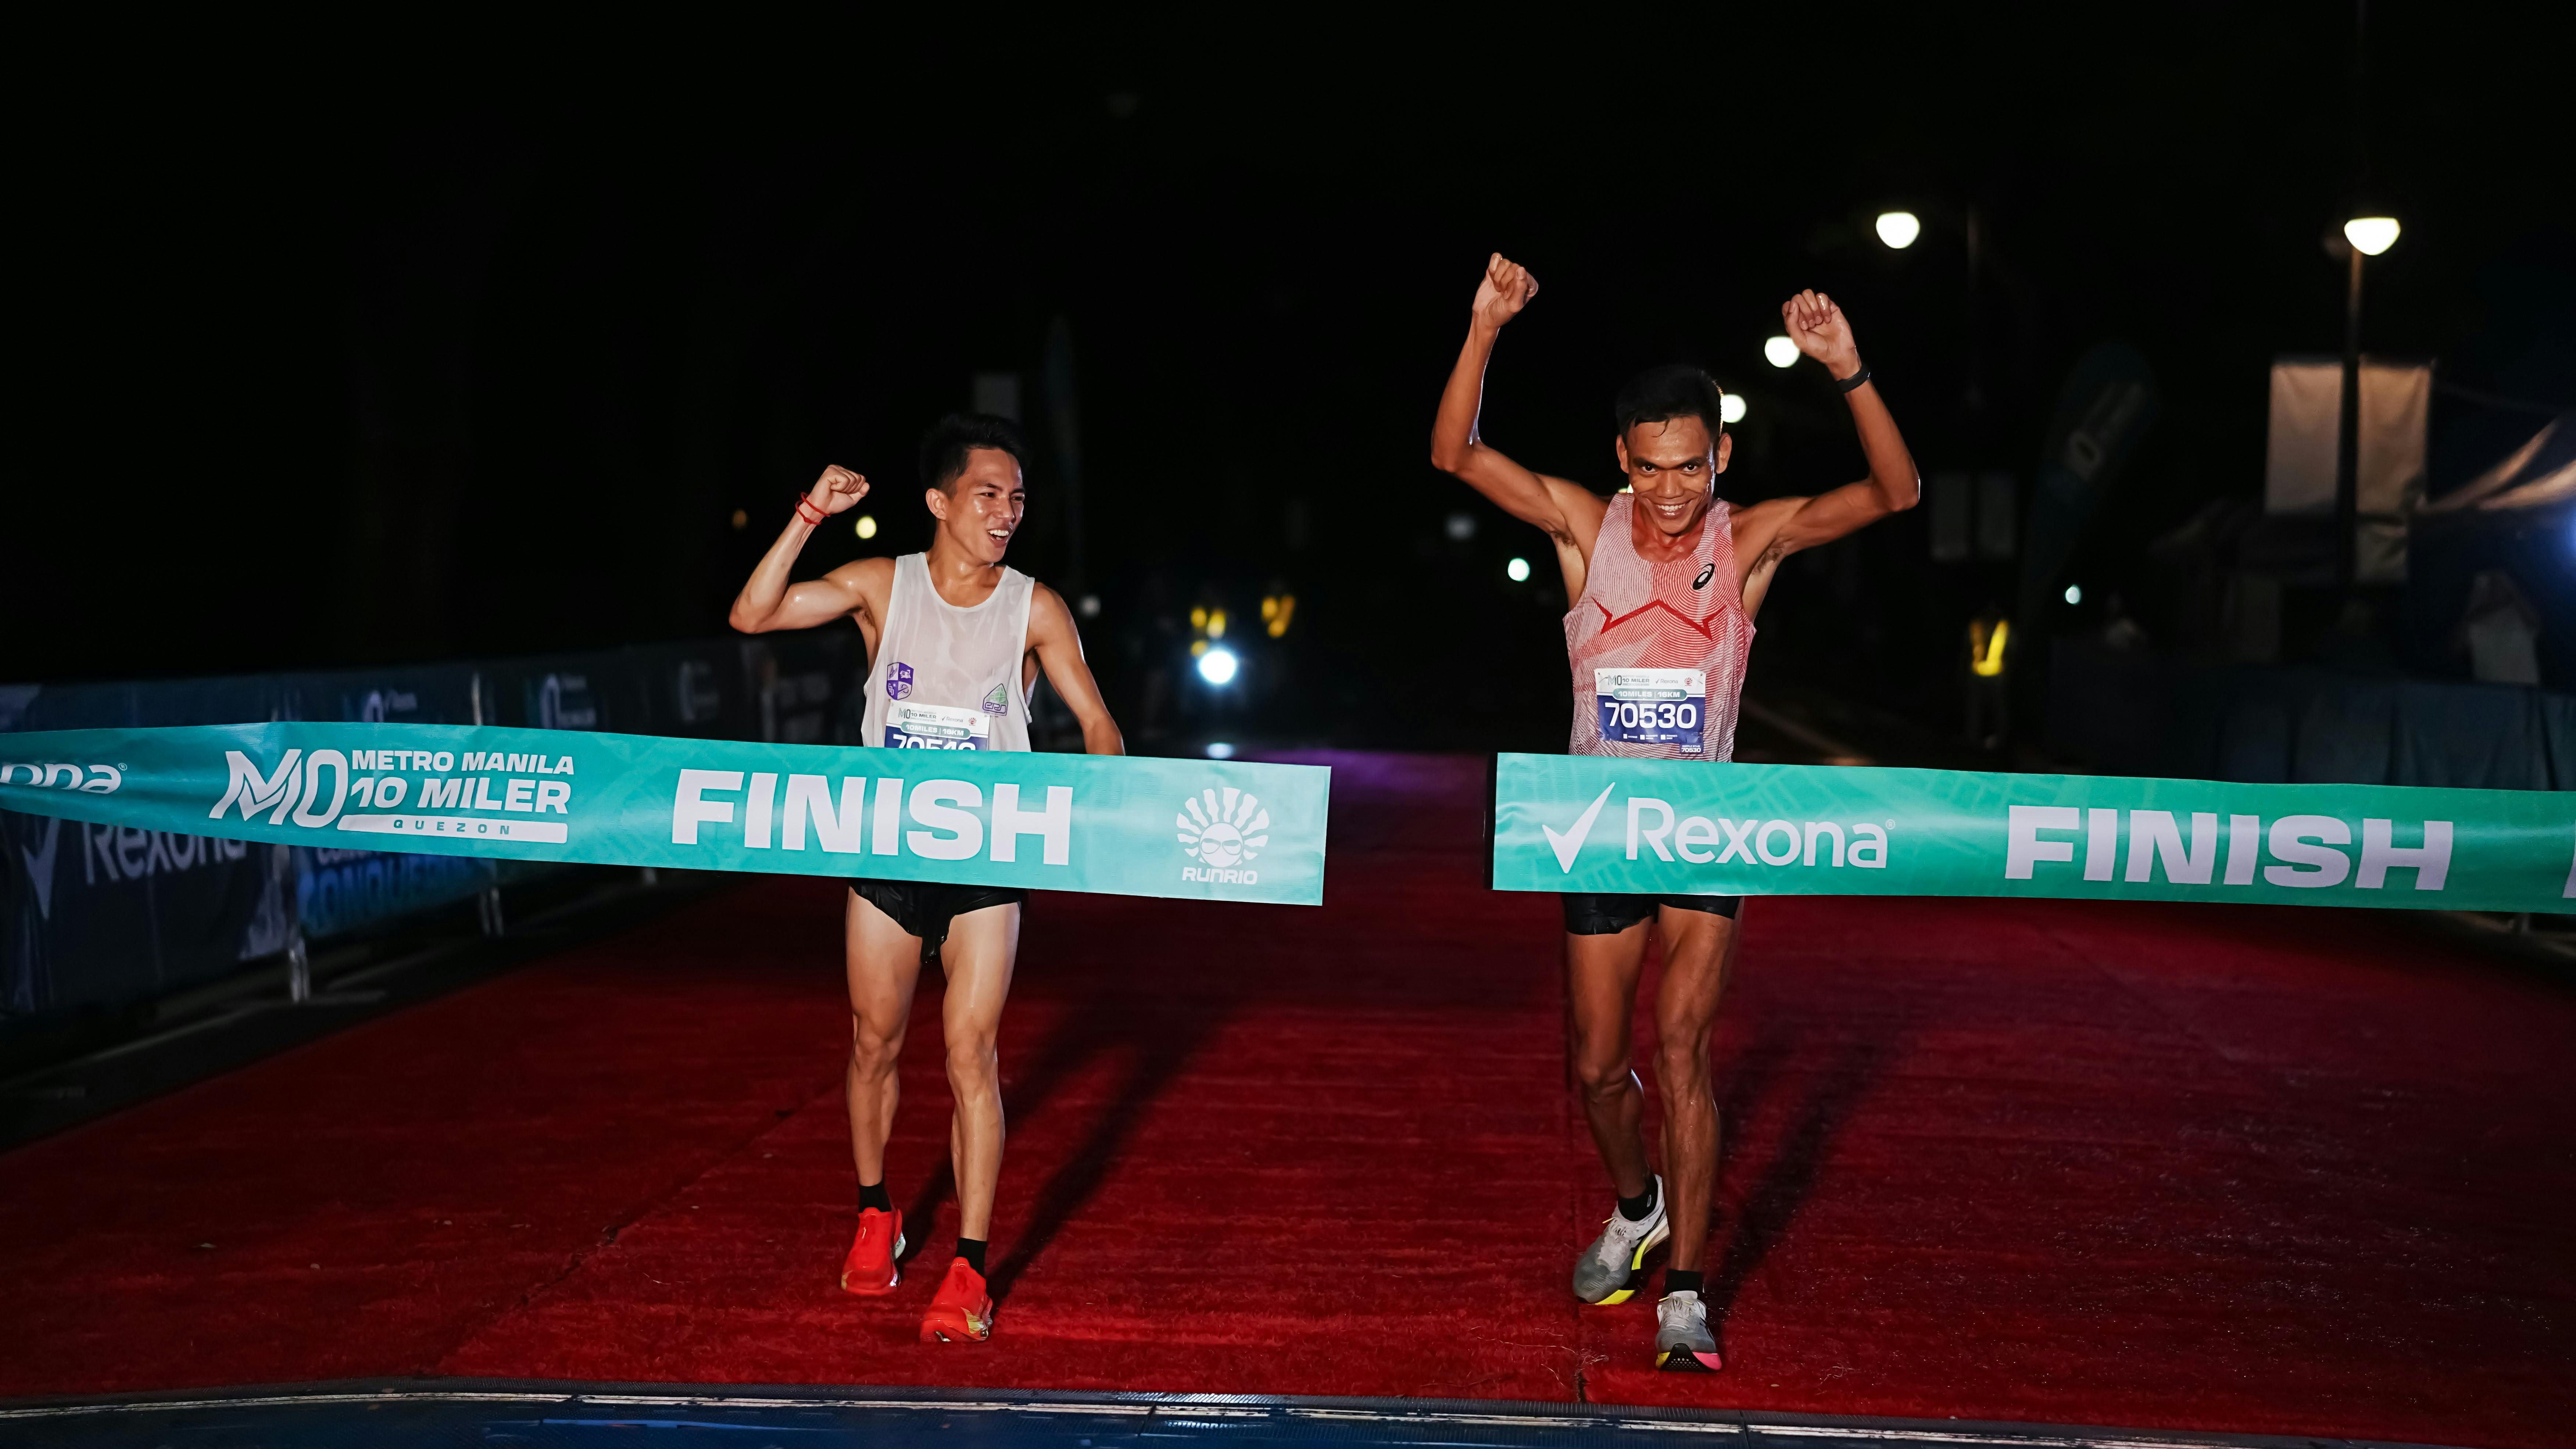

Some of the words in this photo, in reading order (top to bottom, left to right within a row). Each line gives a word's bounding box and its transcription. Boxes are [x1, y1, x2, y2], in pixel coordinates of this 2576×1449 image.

[1605, 702, 1696, 729] 70530
[906, 724, 937, 733] 10MILES
[352, 750, 454, 772] METRO
[461, 752, 574, 774] MANILA
[350, 777, 407, 808] 10
[417, 777, 571, 814] MILER
[393, 819, 509, 835] QUEZON
[672, 768, 1073, 866] FINISH
[2004, 805, 2454, 891] FINISH
[1182, 867, 1258, 885] RUNRIO
